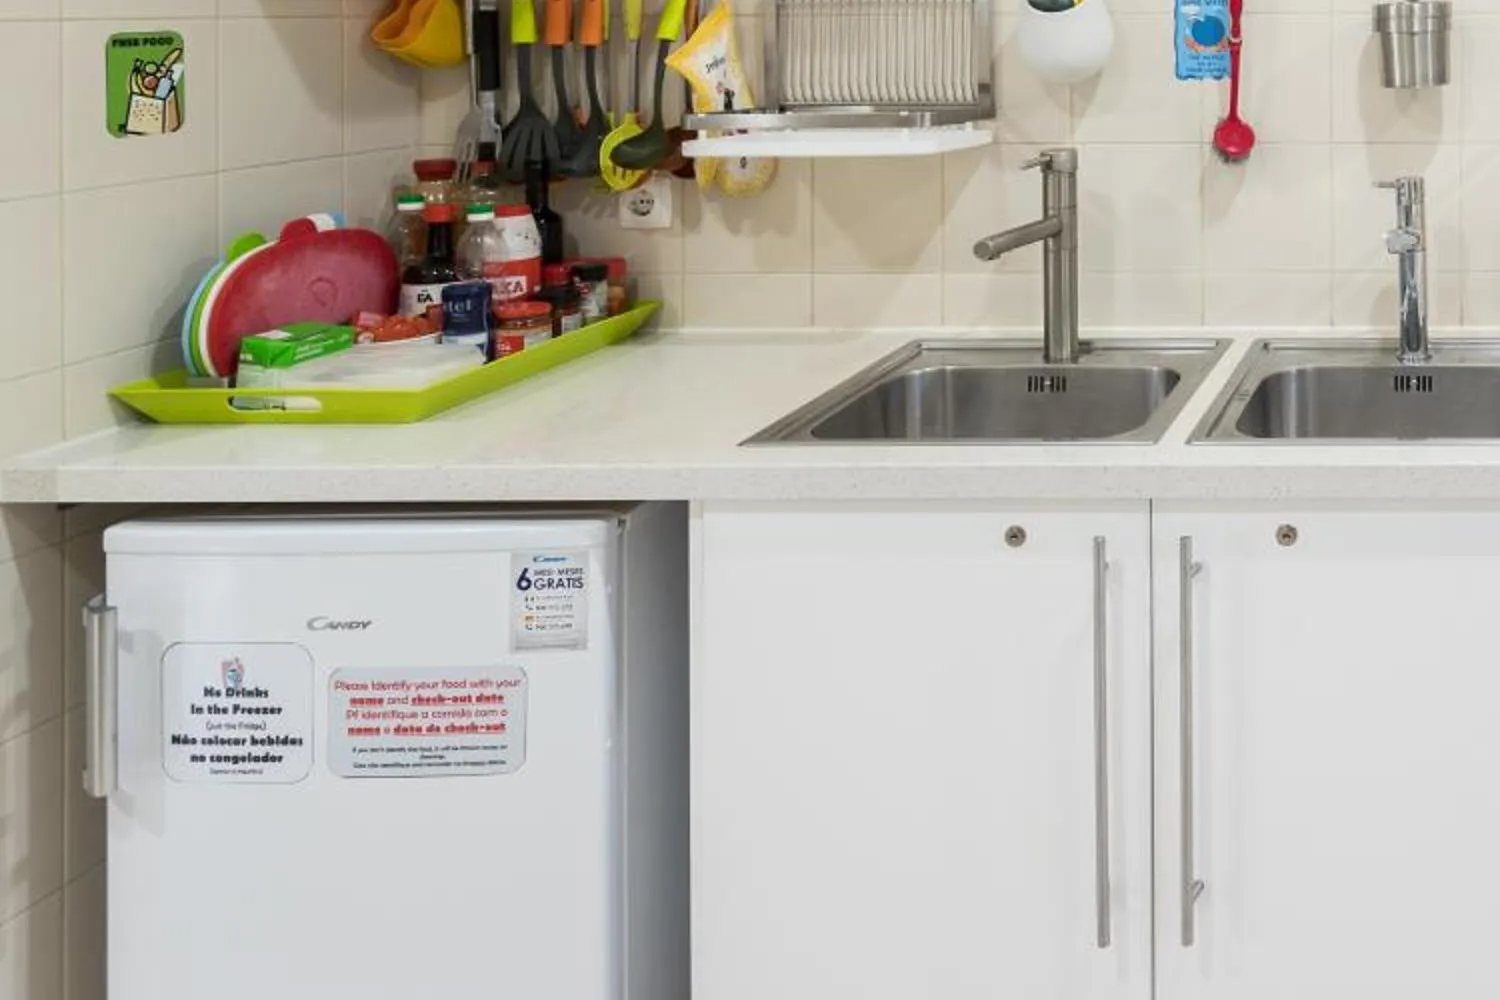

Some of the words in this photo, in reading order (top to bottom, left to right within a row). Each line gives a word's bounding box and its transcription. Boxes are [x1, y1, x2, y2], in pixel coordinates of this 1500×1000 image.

[517, 567, 532, 591] 6
[534, 577, 584, 590] GRATIS
[203, 686, 222, 699] No
[225, 686, 269, 699] Drinks
[190, 704, 204, 715] In
[207, 704, 228, 715] the
[232, 704, 283, 715] Freezer
[171, 733, 198, 746] Não
[201, 733, 247, 746] colocar
[250, 733, 303, 746] bebidas
[190, 753, 207, 763] no
[209, 751, 284, 765] congelador
